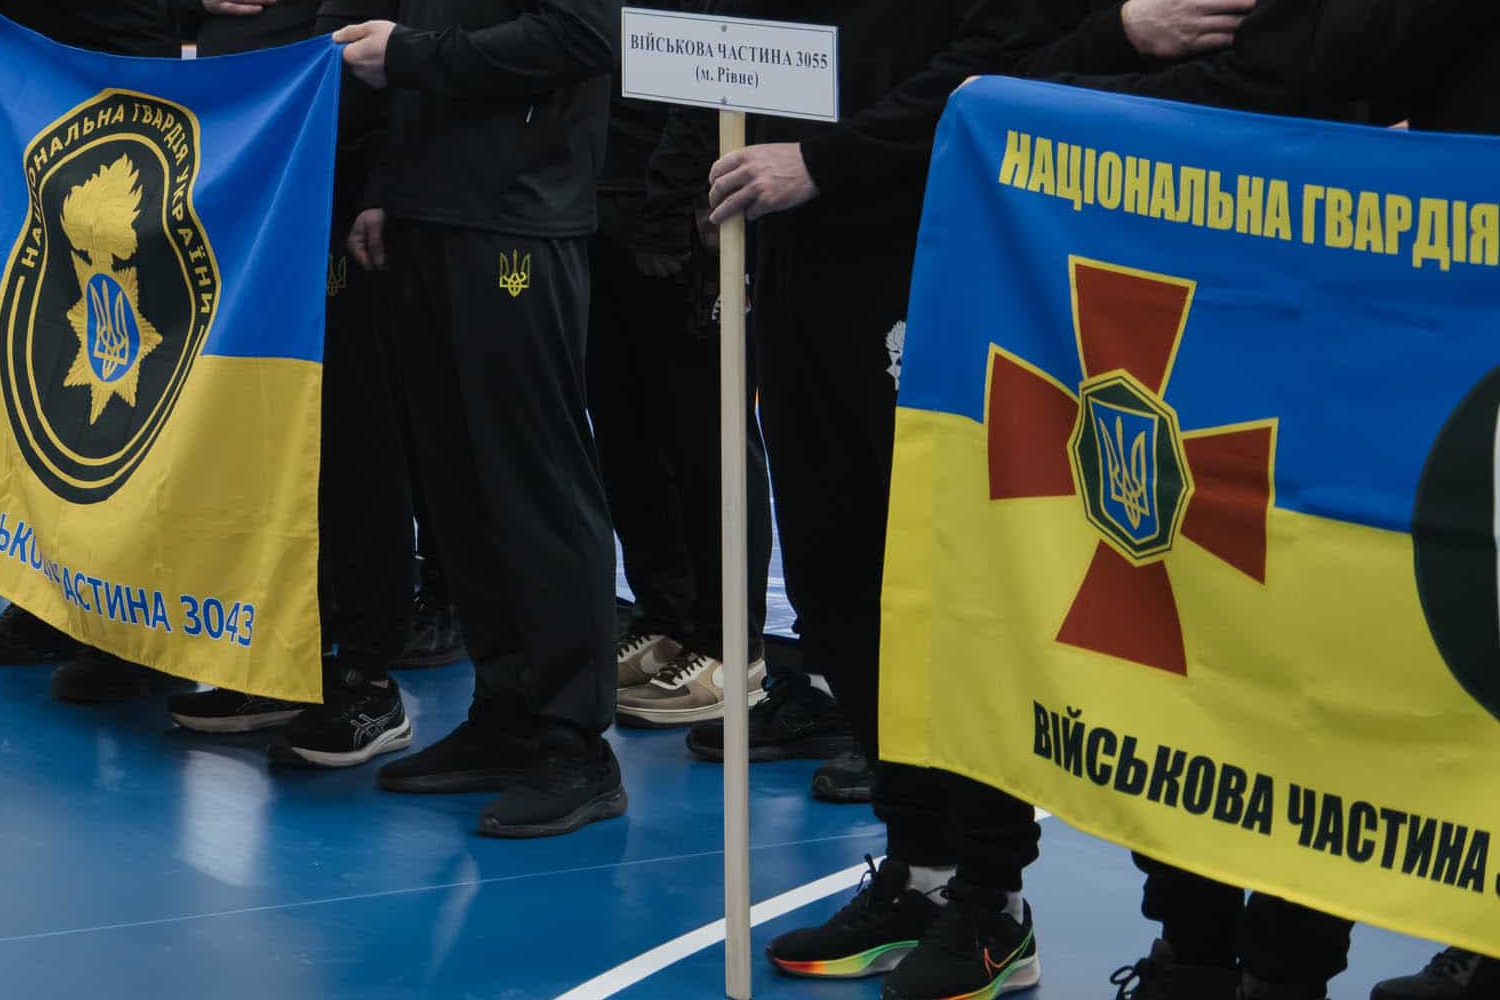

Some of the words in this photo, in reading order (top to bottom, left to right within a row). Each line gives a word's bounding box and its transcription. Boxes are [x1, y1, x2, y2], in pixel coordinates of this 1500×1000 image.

[630, 32, 714, 58] ВІЙСЬКОВА
[718, 44, 792, 66] ЧАСТИНА
[796, 51, 828, 70] 3055
[695, 63, 714, 82] (м.
[717, 66, 759, 89] Рівне)
[132, 103, 189, 165] ГВАРДІЯ
[172, 167, 213, 315] УКРАЇНИ
[997, 129, 1292, 242] НАЦІОНАЛЬНА
[1301, 184, 1499, 272] ГВАРДІЯ
[180, 594, 255, 646] 3043
[1032, 698, 1275, 837] ВІЙСЬКОВА
[1289, 783, 1491, 894] ЧАСТИНА
